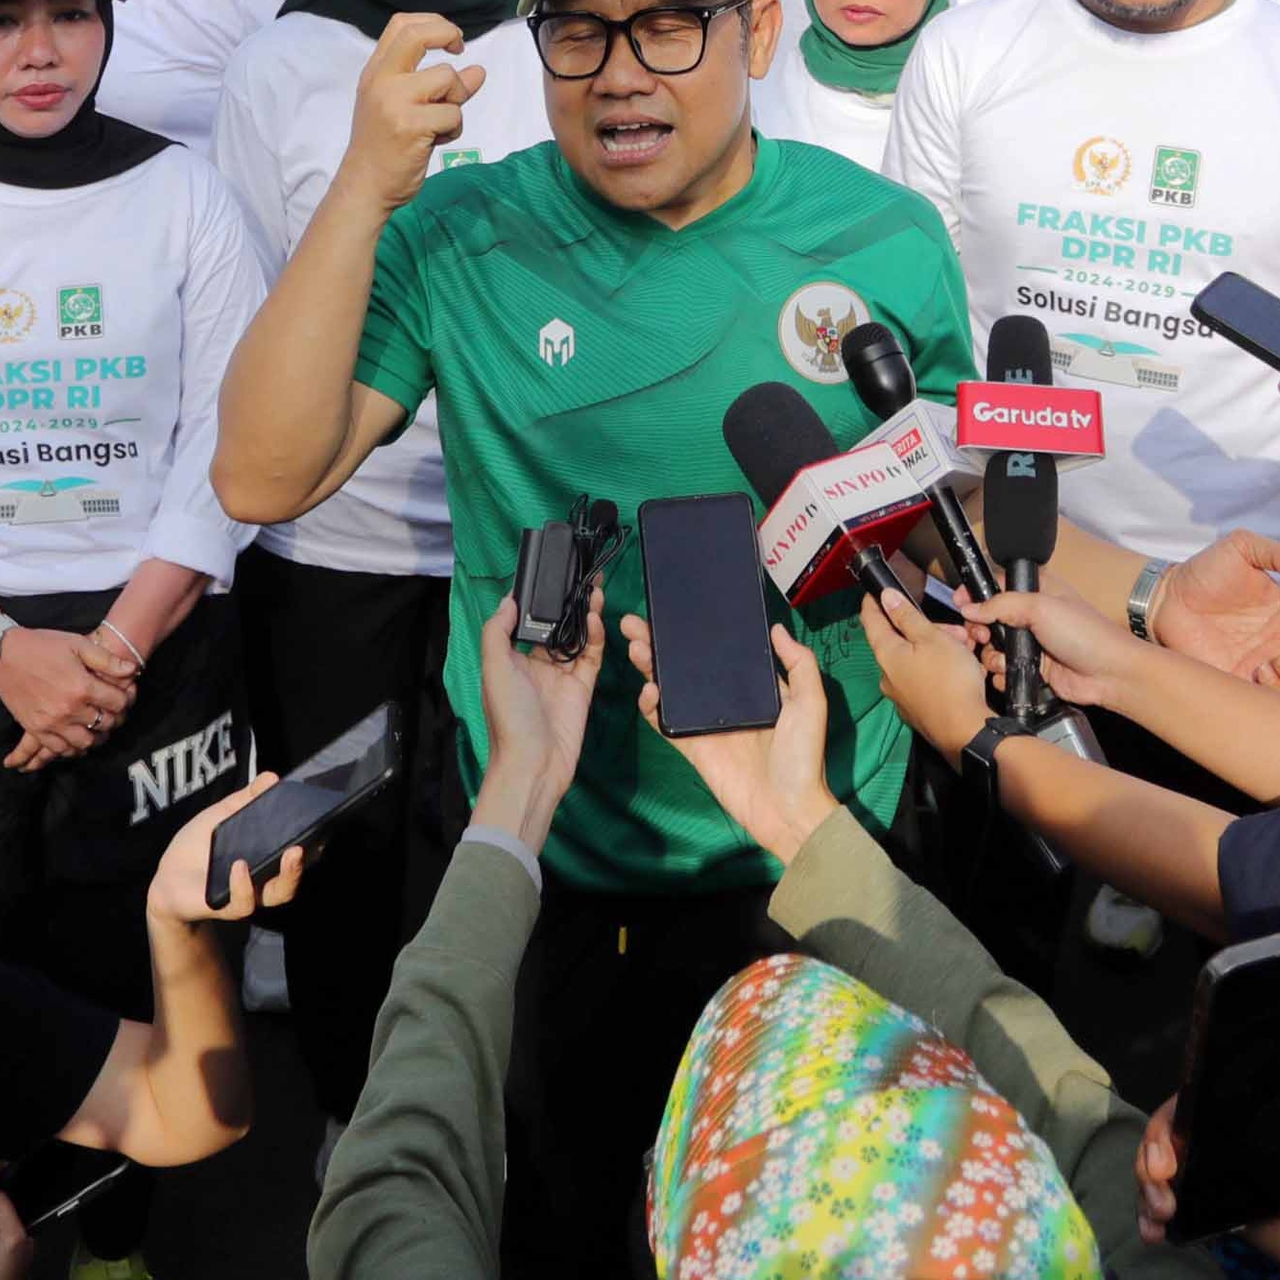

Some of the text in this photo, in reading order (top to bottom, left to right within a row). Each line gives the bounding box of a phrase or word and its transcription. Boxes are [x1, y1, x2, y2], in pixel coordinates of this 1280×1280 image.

[1151, 189, 1192, 205] PKB
[1016, 202, 1234, 257] FRAKSI PKB
[1061, 235, 1183, 276] DPR RI
[1063, 268, 1176, 298] 2024-2029
[1016, 285, 1098, 318] Solusi
[60, 324, 102, 337] PKB
[74, 355, 147, 380] PKB
[67, 385, 101, 409] RI
[36, 441, 138, 466] Bangsa
[128, 709, 237, 826] NIKE
